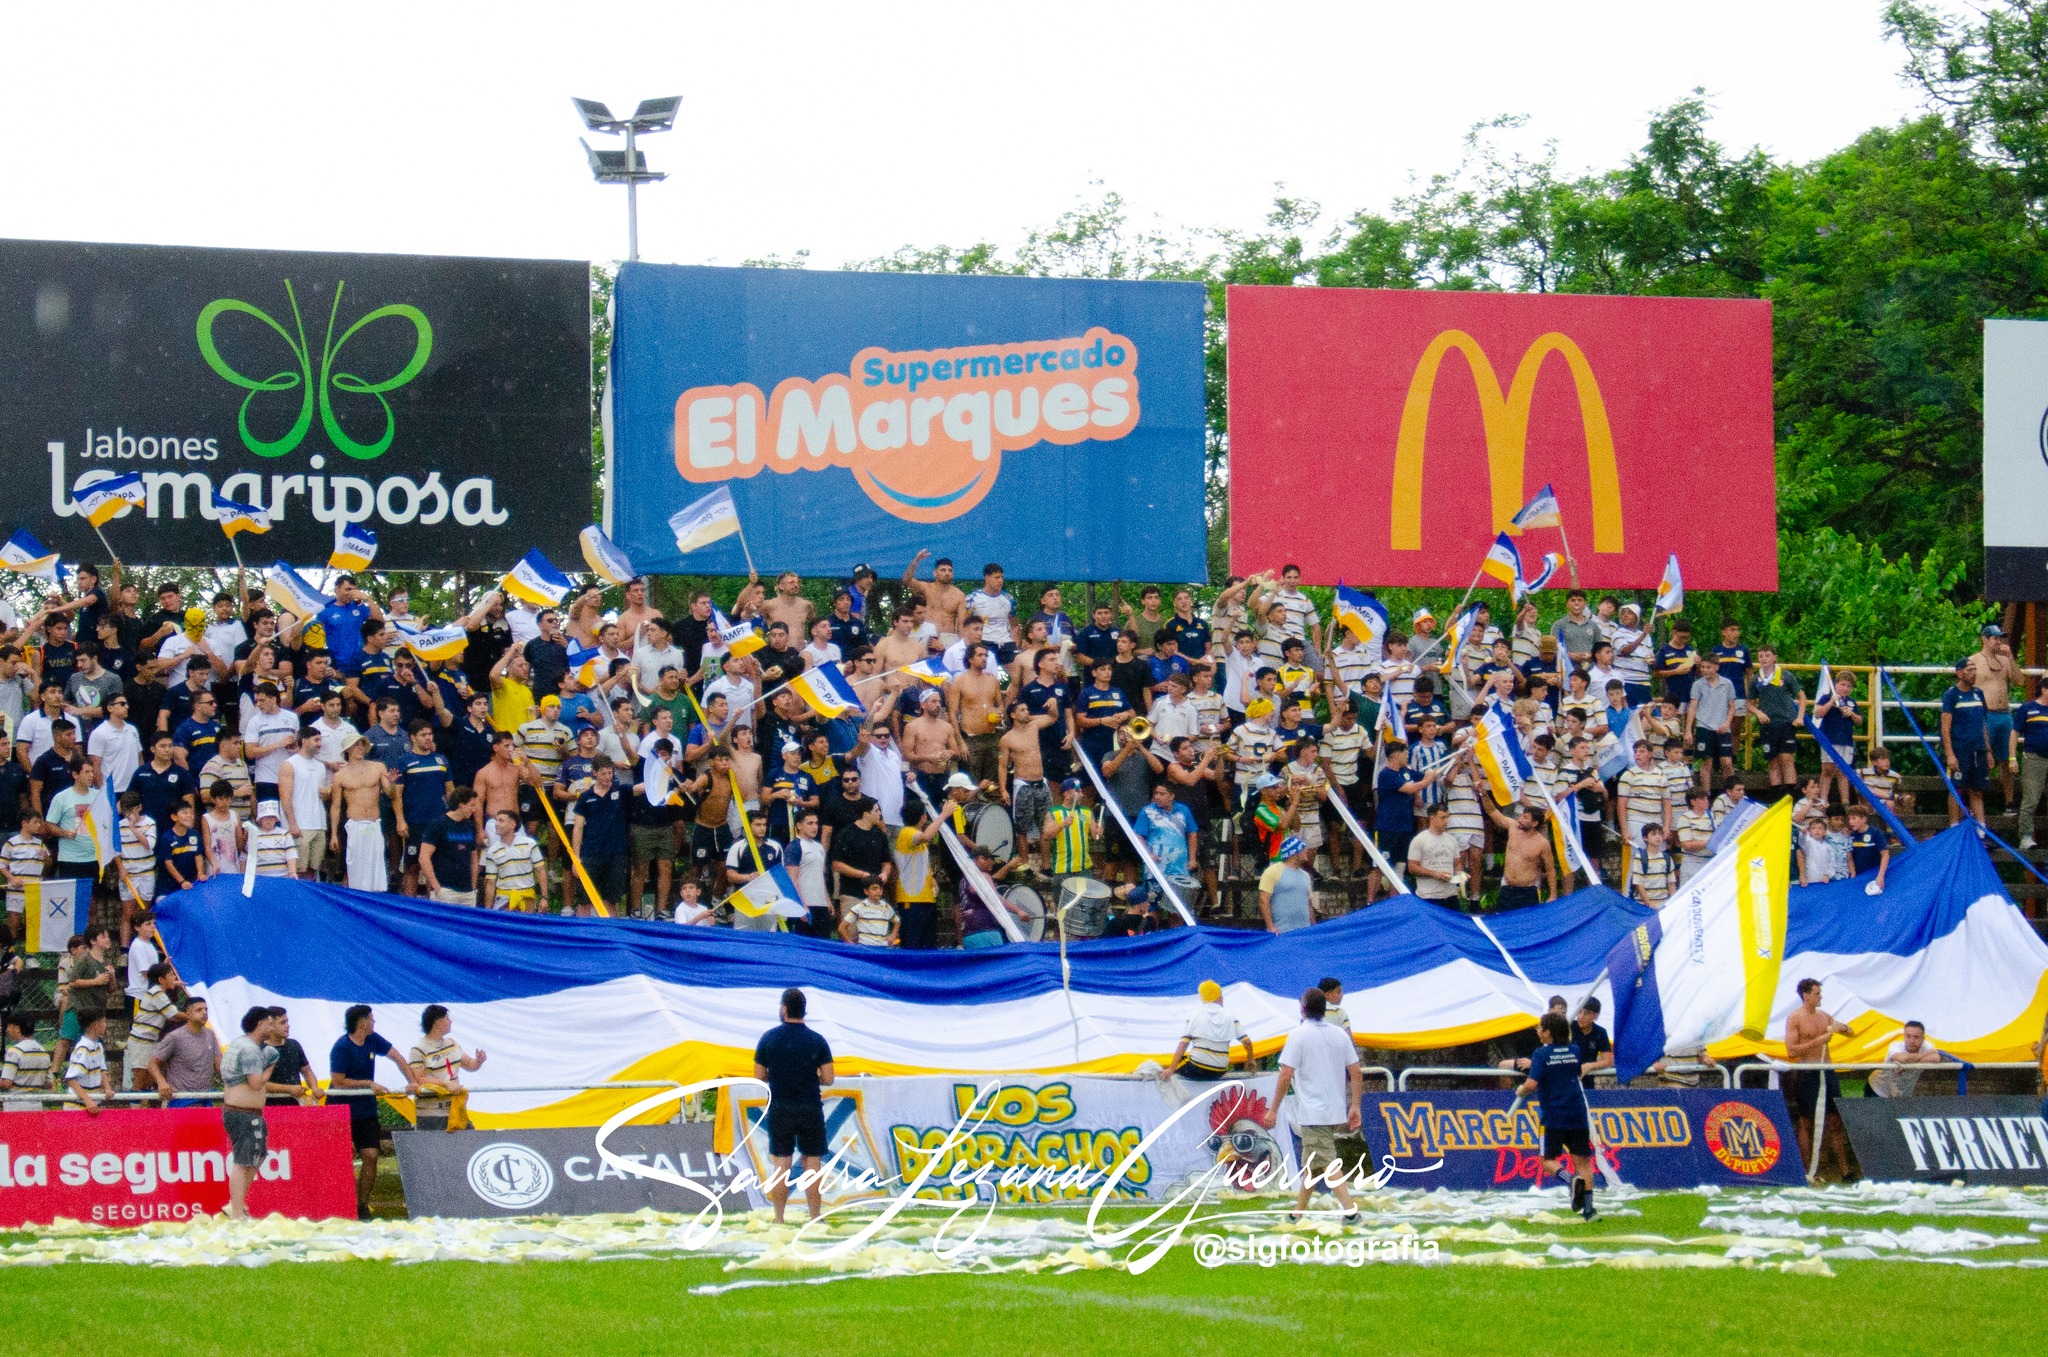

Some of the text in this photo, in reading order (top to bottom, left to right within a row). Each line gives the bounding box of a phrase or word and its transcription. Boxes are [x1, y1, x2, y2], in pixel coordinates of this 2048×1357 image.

[863, 339, 1125, 391] Supermercado
[80, 427, 219, 460] Jabones
[688, 377, 1130, 469] El Marques
[1501, 759, 1520, 793] PAMPA
[953, 1081, 1077, 1128] LOS
[59, 1150, 291, 1194] seguna
[889, 1124, 1153, 1187] BORRACHOS
[1715, 1147, 1778, 1174] DEPORTES
[92, 1203, 203, 1220] SEGUROS
